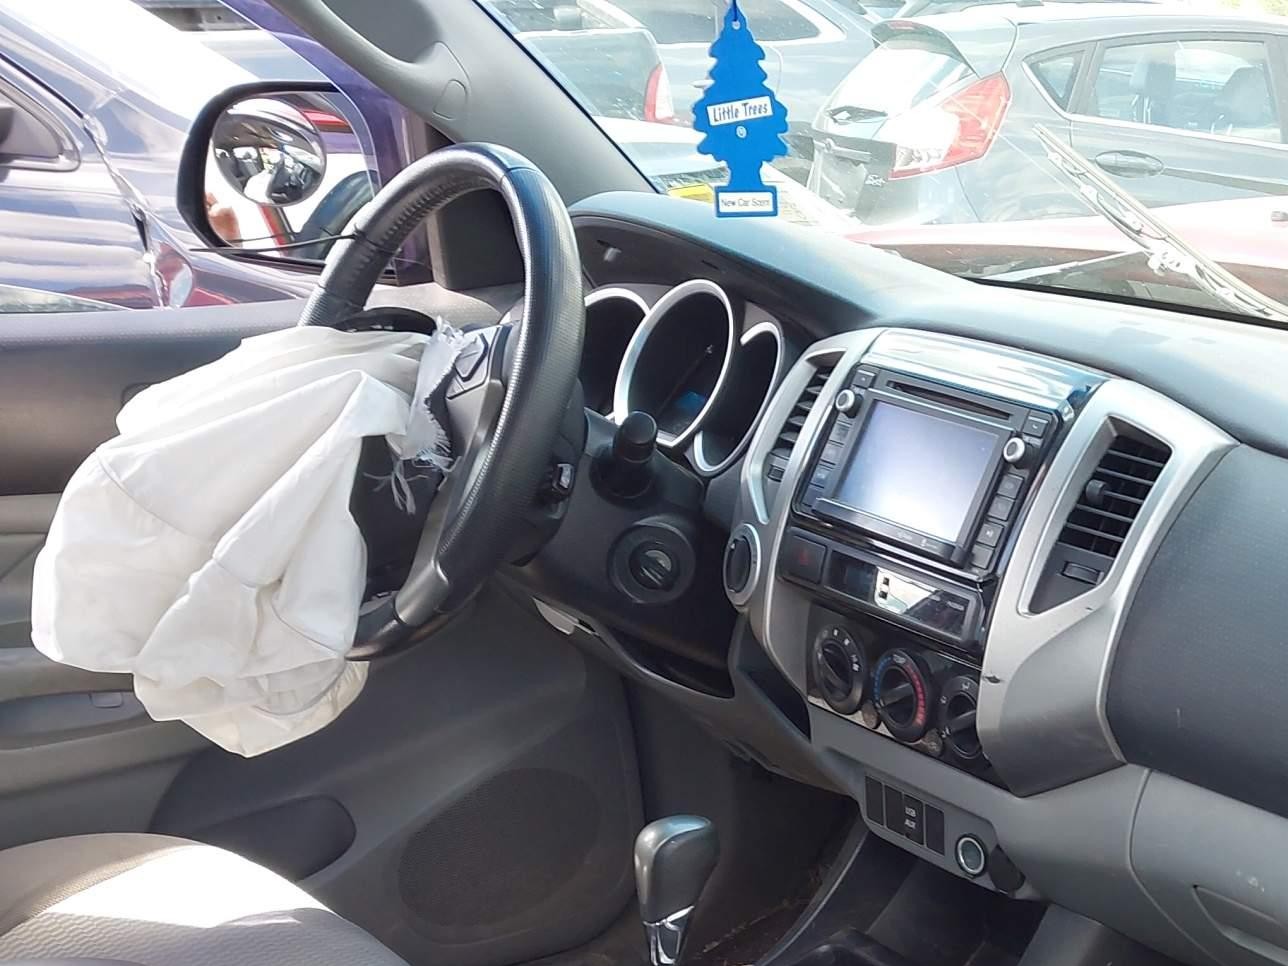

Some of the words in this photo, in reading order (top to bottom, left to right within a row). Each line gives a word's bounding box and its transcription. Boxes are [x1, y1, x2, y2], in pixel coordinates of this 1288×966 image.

[713, 104, 740, 122] Little
[741, 102, 768, 116] Trees
[721, 198, 736, 207] New
[737, 198, 750, 207] Car
